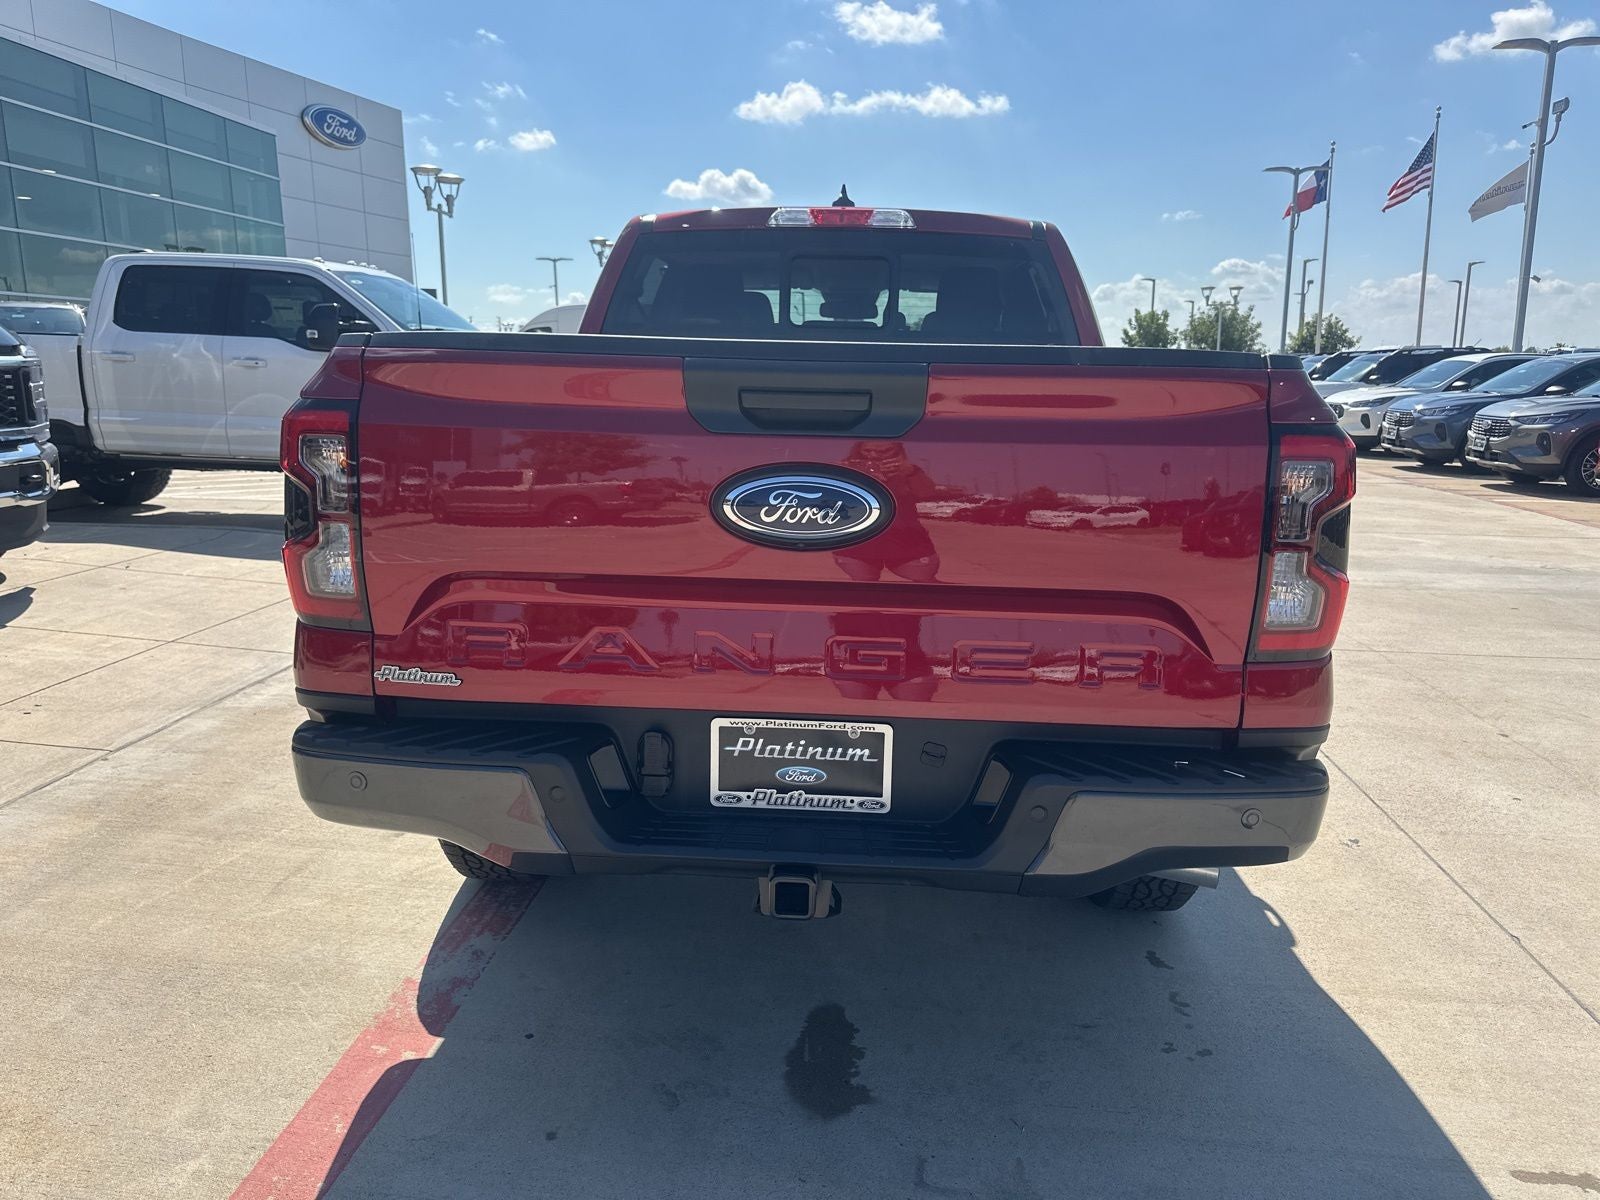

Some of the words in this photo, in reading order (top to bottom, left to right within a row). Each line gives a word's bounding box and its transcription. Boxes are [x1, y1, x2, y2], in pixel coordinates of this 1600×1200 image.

[323, 113, 357, 142] Ford
[759, 489, 843, 525] Ford
[446, 618, 1164, 689] RANGER
[374, 665, 462, 686] Platinum
[729, 719, 876, 732] www.PlatinumFord.com
[724, 737, 879, 762] Platinum
[784, 767, 817, 783] Ford
[718, 795, 739, 805] Ford
[751, 790, 855, 810] Platinum
[862, 800, 882, 809] Ford
